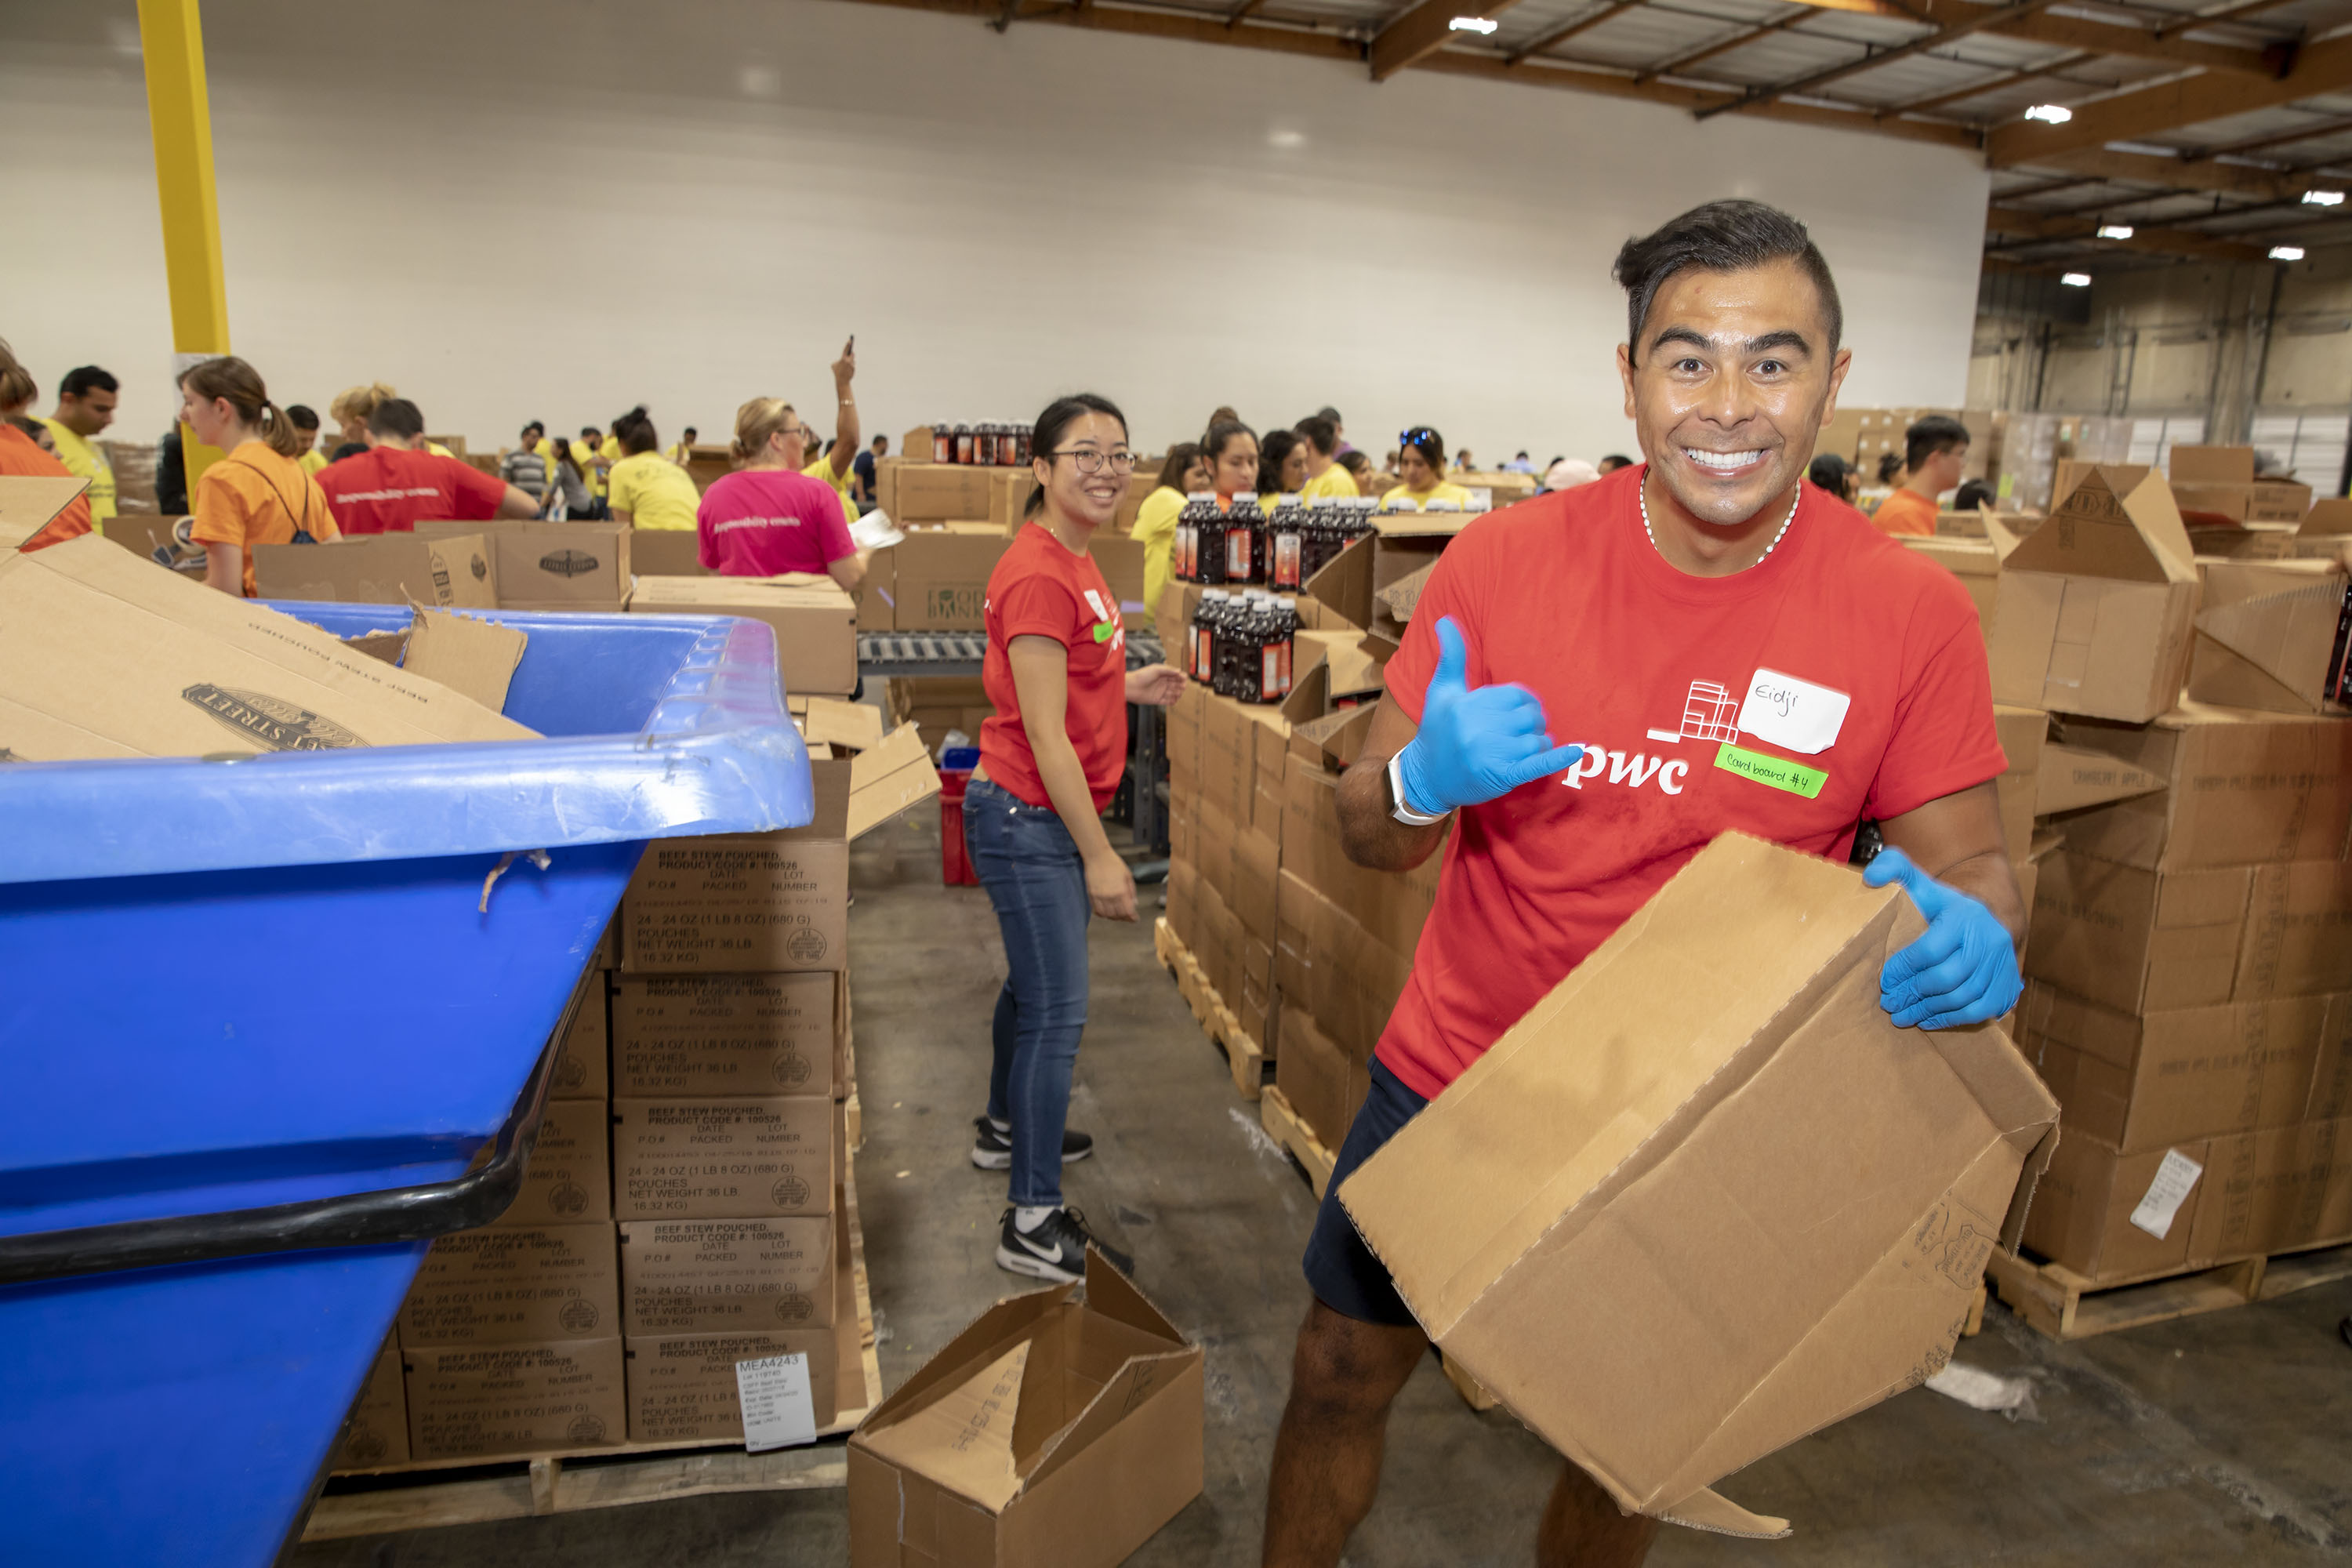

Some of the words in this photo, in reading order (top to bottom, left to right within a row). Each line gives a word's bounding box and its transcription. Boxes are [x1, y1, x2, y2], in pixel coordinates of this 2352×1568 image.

[336, 660, 381, 684] STEW
[387, 684, 429, 704] BEEF
[1755, 684, 1798, 717] Eidji
[198, 691, 285, 740] STREET
[1561, 742, 1690, 796] pwc
[648, 1107, 674, 1116] BEEF
[648, 1116, 699, 1125] PRODUCT
[748, 1115, 781, 1123] 100526
[629, 1167, 641, 1176] 24
[670, 1167, 685, 1175] OZ
[689, 1167, 699, 1177] (1
[702, 1166, 717, 1174] LB
[720, 1166, 728, 1174] 8
[731, 1165, 751, 1175] OZ)
[754, 1164, 778, 1174] (680
[781, 1164, 794, 1173] G)
[629, 1179, 688, 1189] POUCHES
[629, 1190, 652, 1199] NET
[655, 1188, 703, 1197] WEIGHT
[708, 1187, 720, 1196] 36
[666, 1201, 688, 1210] KG)
[655, 1234, 703, 1243] PRODUCT
[752, 1232, 784, 1240] 100526
[760, 1251, 803, 1260] NUMBER
[674, 1286, 690, 1294] OZ
[694, 1285, 704, 1296] (1
[708, 1285, 721, 1294] LB
[735, 1284, 755, 1294] OZ)
[758, 1283, 780, 1294] (680
[784, 1283, 797, 1293] G)
[635, 1298, 693, 1306] POUCHES
[636, 1307, 659, 1316] NET
[662, 1306, 707, 1315] WEIGHT
[673, 1317, 693, 1327] KG)
[660, 1348, 709, 1357] PRODUCT
[756, 1344, 787, 1352] 100526
[700, 1365, 735, 1374] PACKE
[740, 1356, 798, 1372] MEA4243
[681, 1395, 696, 1403] OZ
[700, 1394, 709, 1403] (1
[713, 1393, 728, 1402] LB
[642, 1406, 698, 1417] POUCHES
[642, 1417, 663, 1426] NET
[669, 1416, 713, 1425] WEIGHT
[717, 1414, 730, 1423] 36
[678, 1427, 699, 1436] KG)
